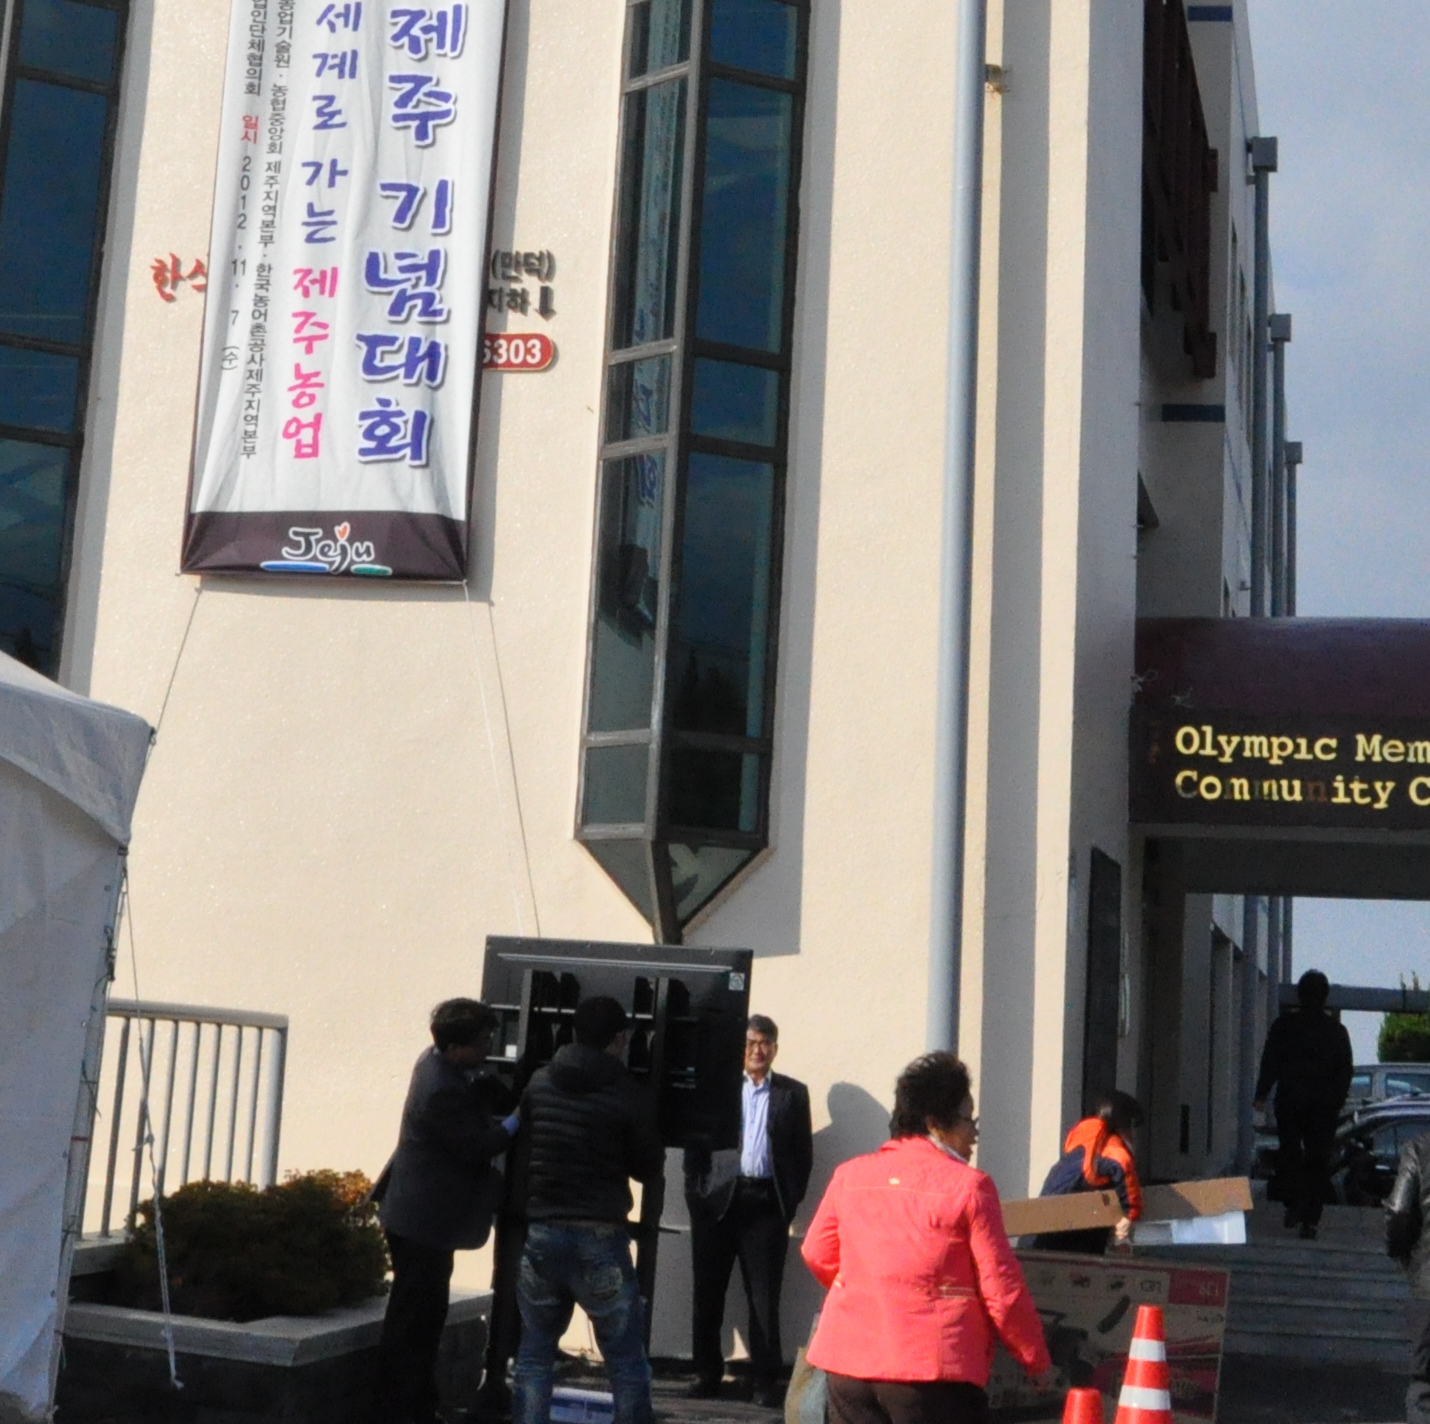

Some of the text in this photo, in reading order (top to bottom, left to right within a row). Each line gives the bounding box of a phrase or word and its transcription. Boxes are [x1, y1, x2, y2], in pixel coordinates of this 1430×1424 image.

[311, 1, 362, 131] 세계로
[301, 158, 349, 244] 가는
[282, 266, 338, 459] 제주농업
[282, 526, 376, 572] Jeju
[1175, 726, 1337, 765] Olympic
